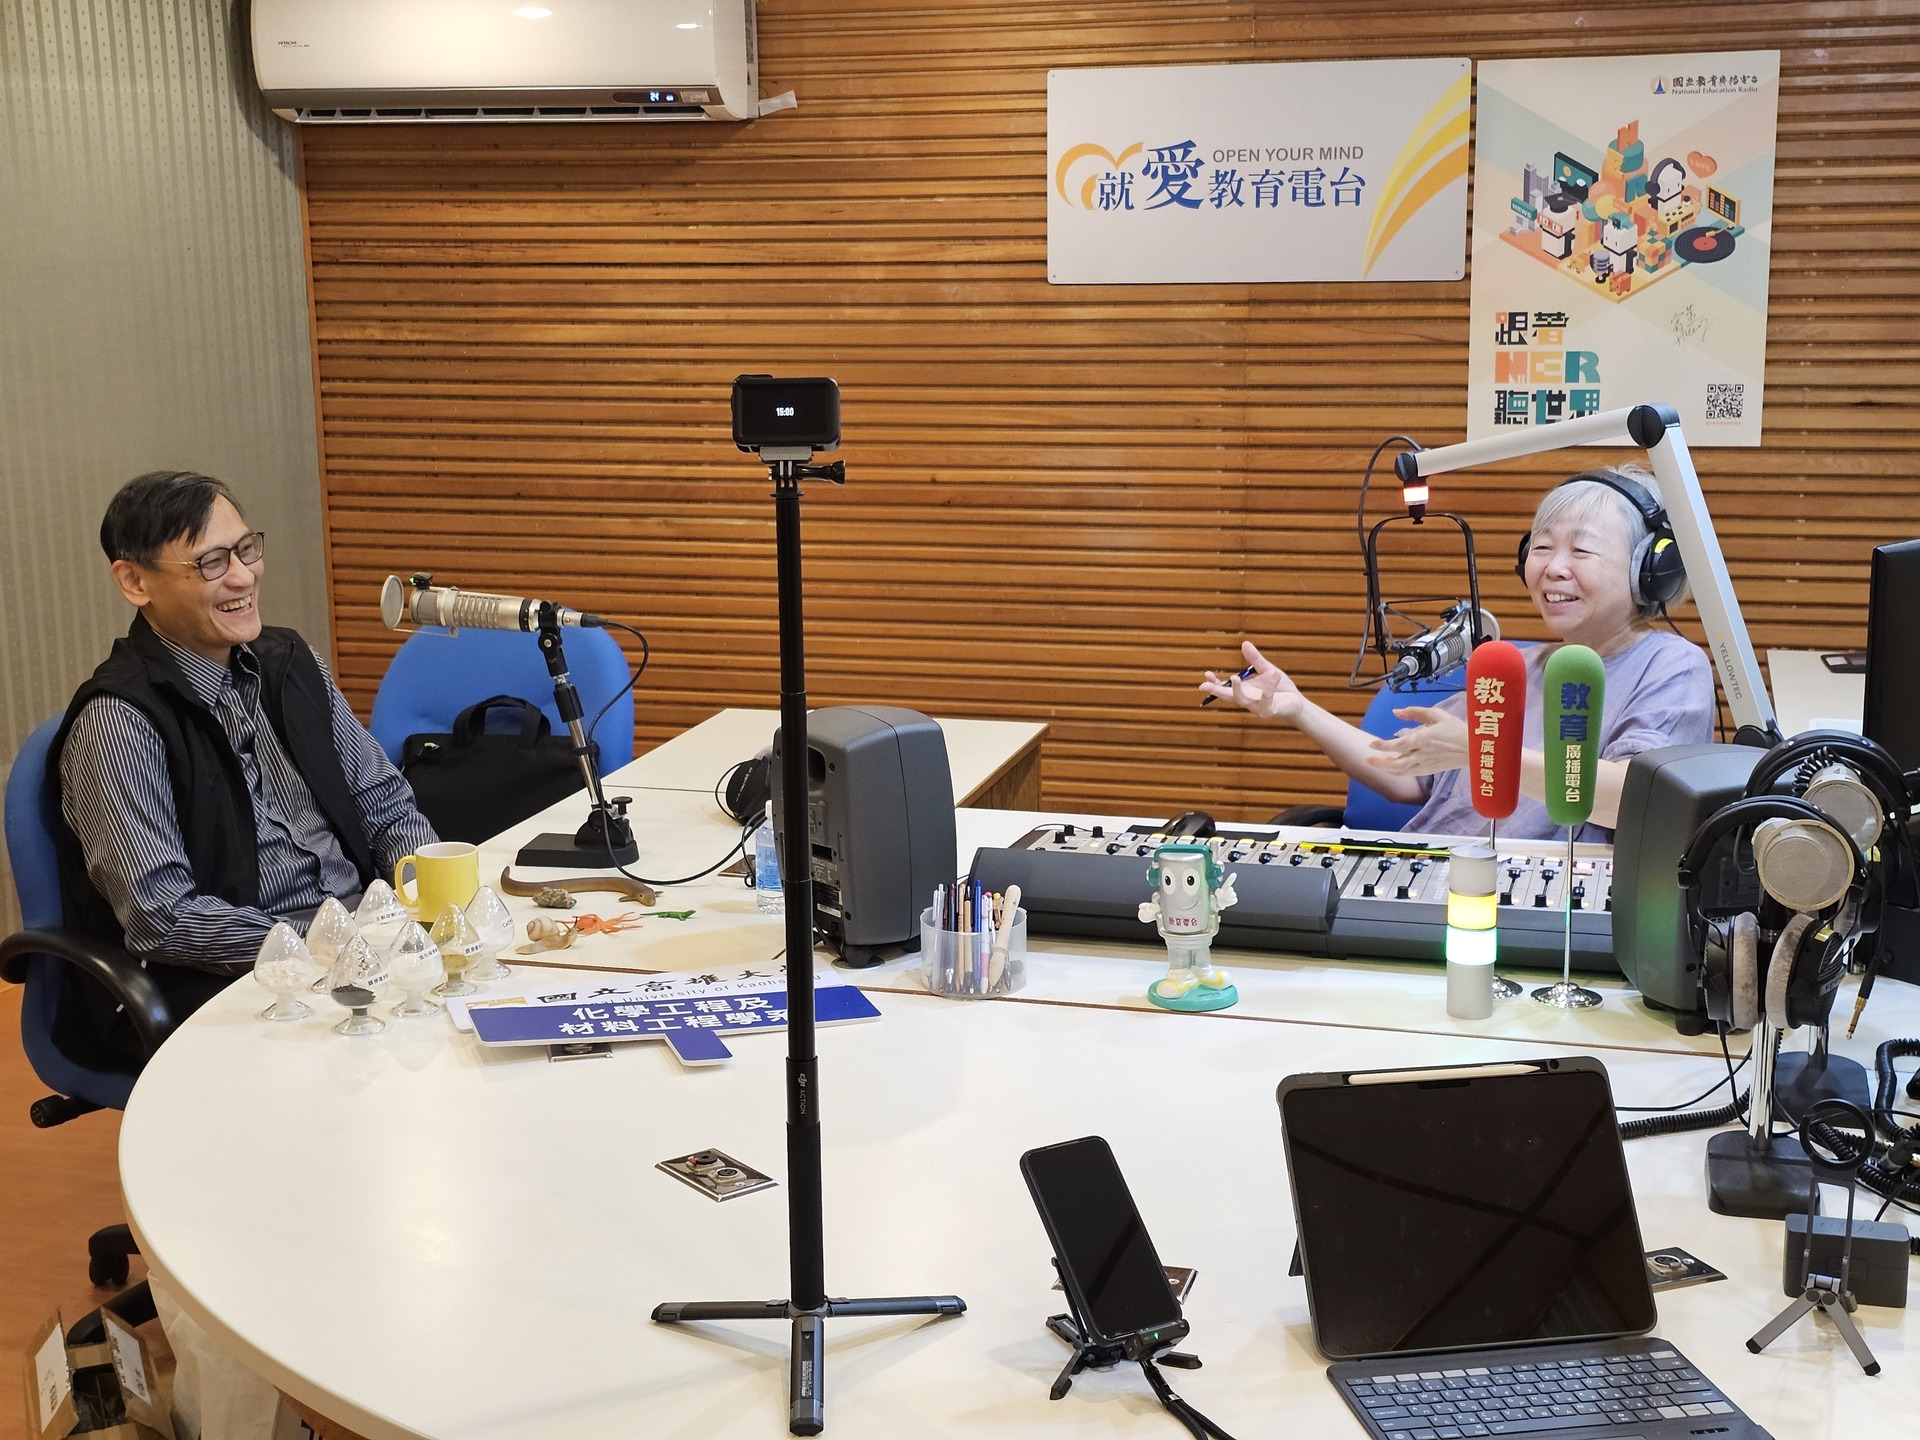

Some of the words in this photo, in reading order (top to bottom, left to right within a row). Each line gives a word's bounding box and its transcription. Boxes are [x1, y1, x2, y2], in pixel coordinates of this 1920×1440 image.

[1212, 150, 1260, 163] OPEN
[1265, 148, 1314, 162] YOUR
[1319, 146, 1364, 160] MIND
[1098, 139, 1367, 212] 就愛教育電台
[1512, 203, 1532, 219] NEWS
[1495, 312, 1570, 345] 跟著
[776, 407, 794, 416] 15:00
[1494, 389, 1601, 425] 聽世界
[1719, 642, 1742, 699] YELLOWTEC
[1474, 677, 1505, 738] 教育
[1560, 682, 1591, 742] 教育
[1480, 740, 1495, 797] 廣播電台
[1566, 745, 1582, 803] 廣播電台
[537, 964, 787, 1003] 國立高雄大
[622, 987, 705, 1001] University
[559, 1009, 788, 1035] 材料工程學系
[572, 996, 773, 1021] 化學工程及
